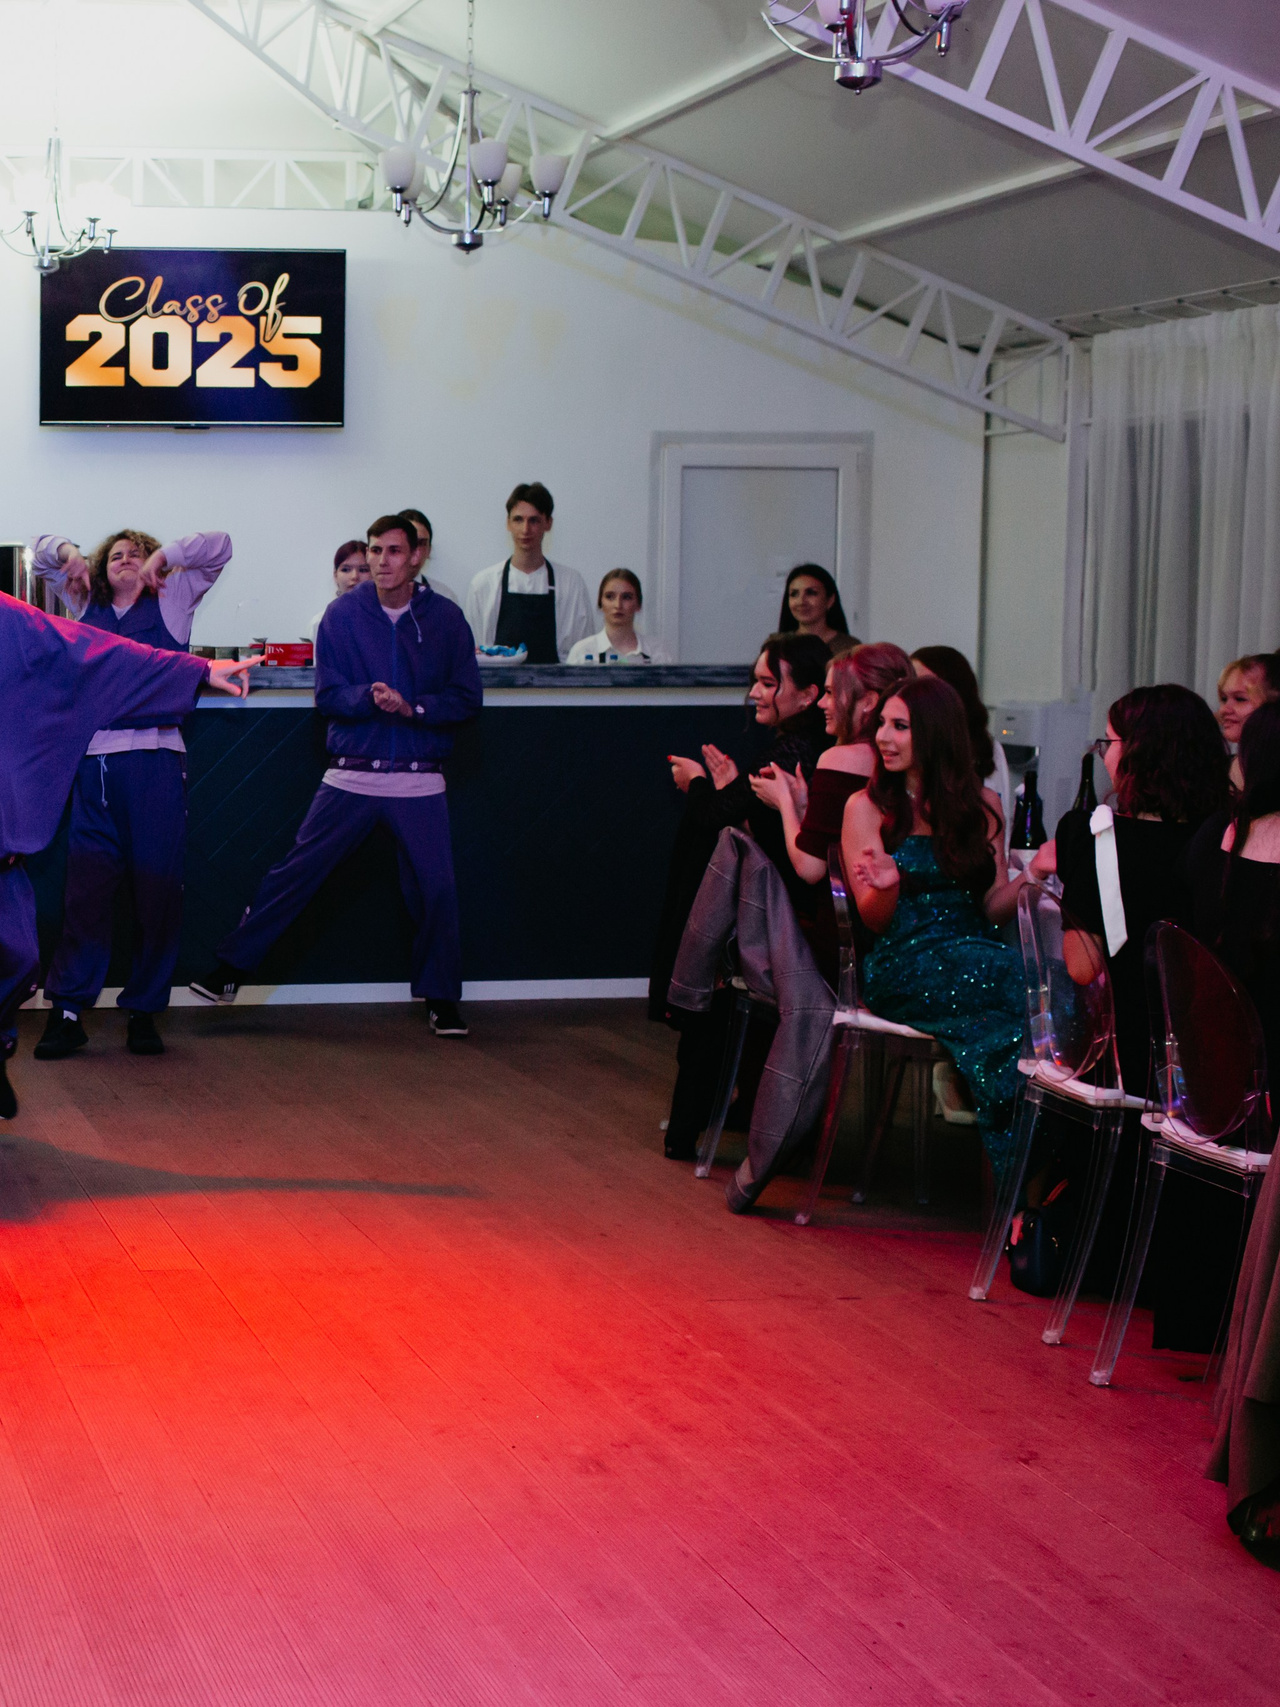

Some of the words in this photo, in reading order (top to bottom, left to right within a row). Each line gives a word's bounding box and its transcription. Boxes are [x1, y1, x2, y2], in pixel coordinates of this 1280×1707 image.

[98, 275, 227, 323] Class
[237, 273, 290, 342] Of
[65, 314, 322, 388] 2025
